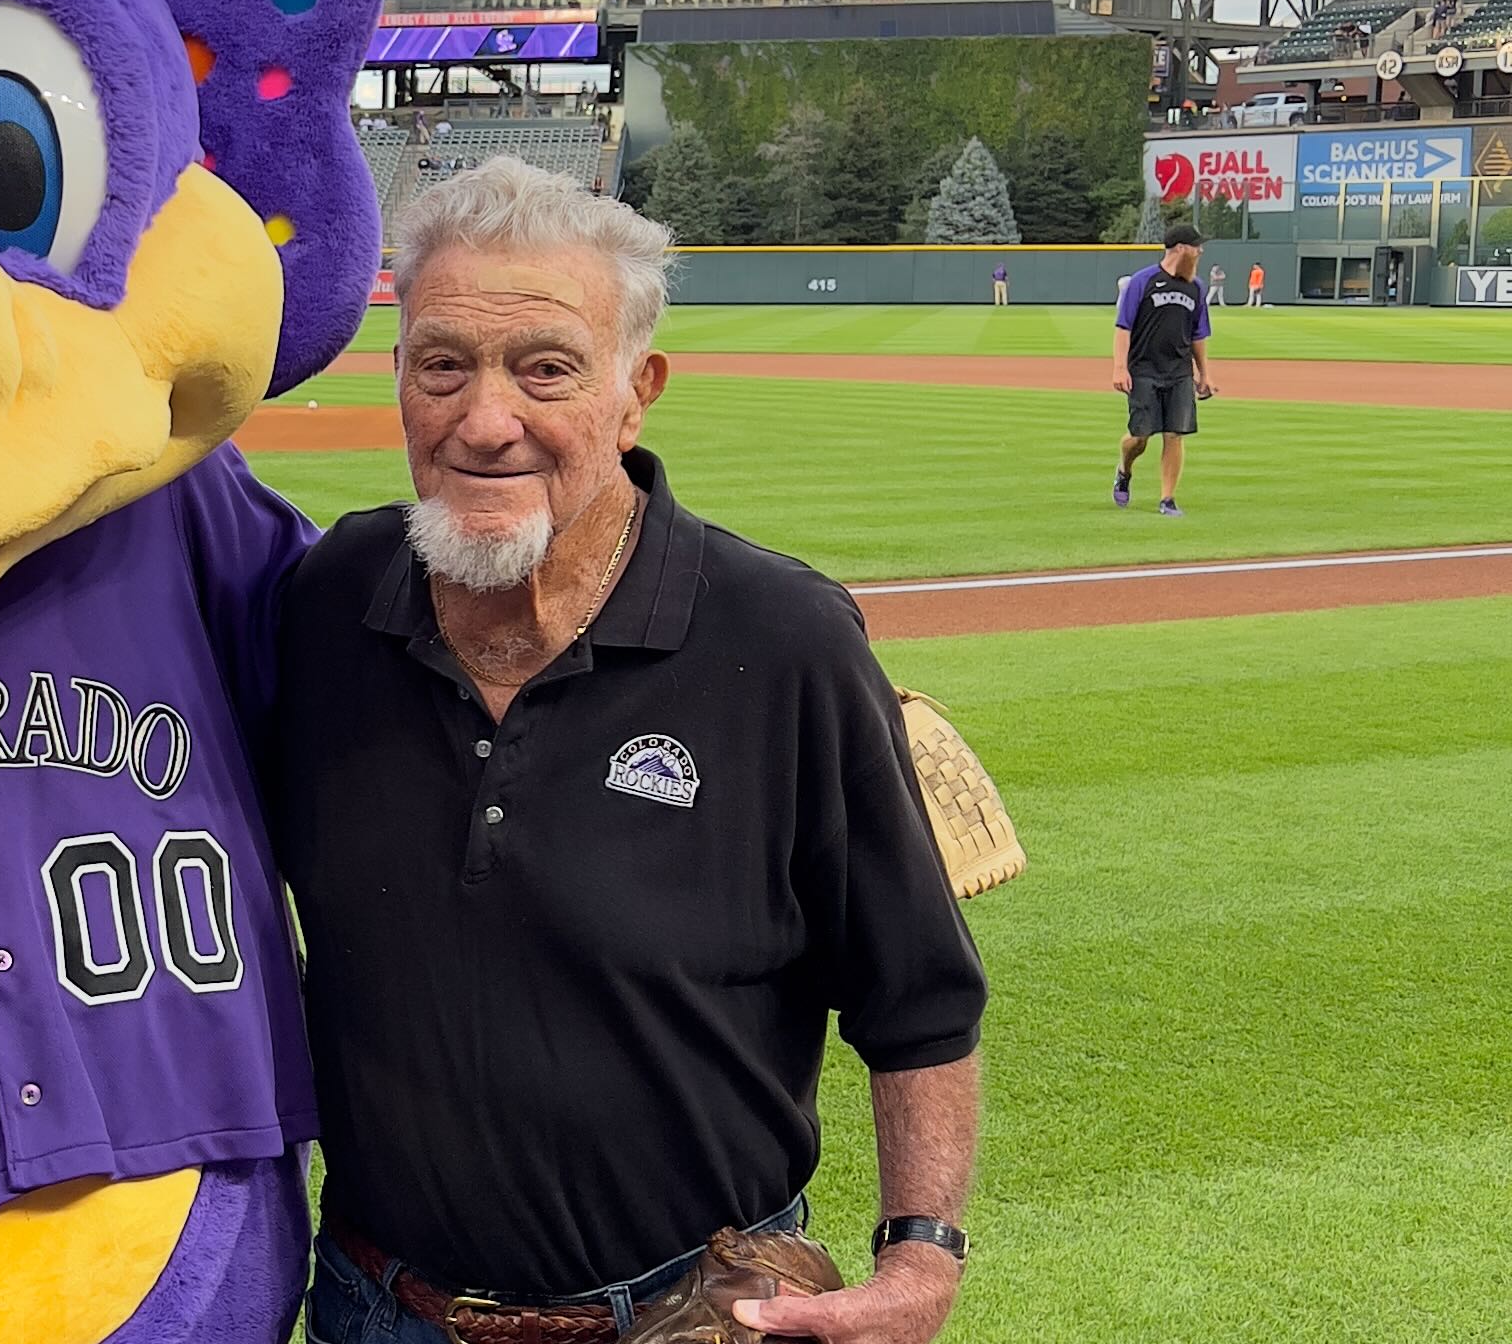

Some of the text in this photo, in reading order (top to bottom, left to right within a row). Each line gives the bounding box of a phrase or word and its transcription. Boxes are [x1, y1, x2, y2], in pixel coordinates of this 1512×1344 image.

[1380, 60, 1397, 74] 42
[1330, 140, 1419, 162] BACHUS
[1303, 162, 1418, 183] SCHANKER
[1408, 193, 1432, 204] LAW
[1441, 192, 1461, 204] IRM
[808, 278, 837, 292] 415
[1467, 270, 1512, 302] YE
[620, 738, 692, 776] COLORADO
[613, 764, 694, 800] ROCKIES
[41, 830, 244, 1005] 00
